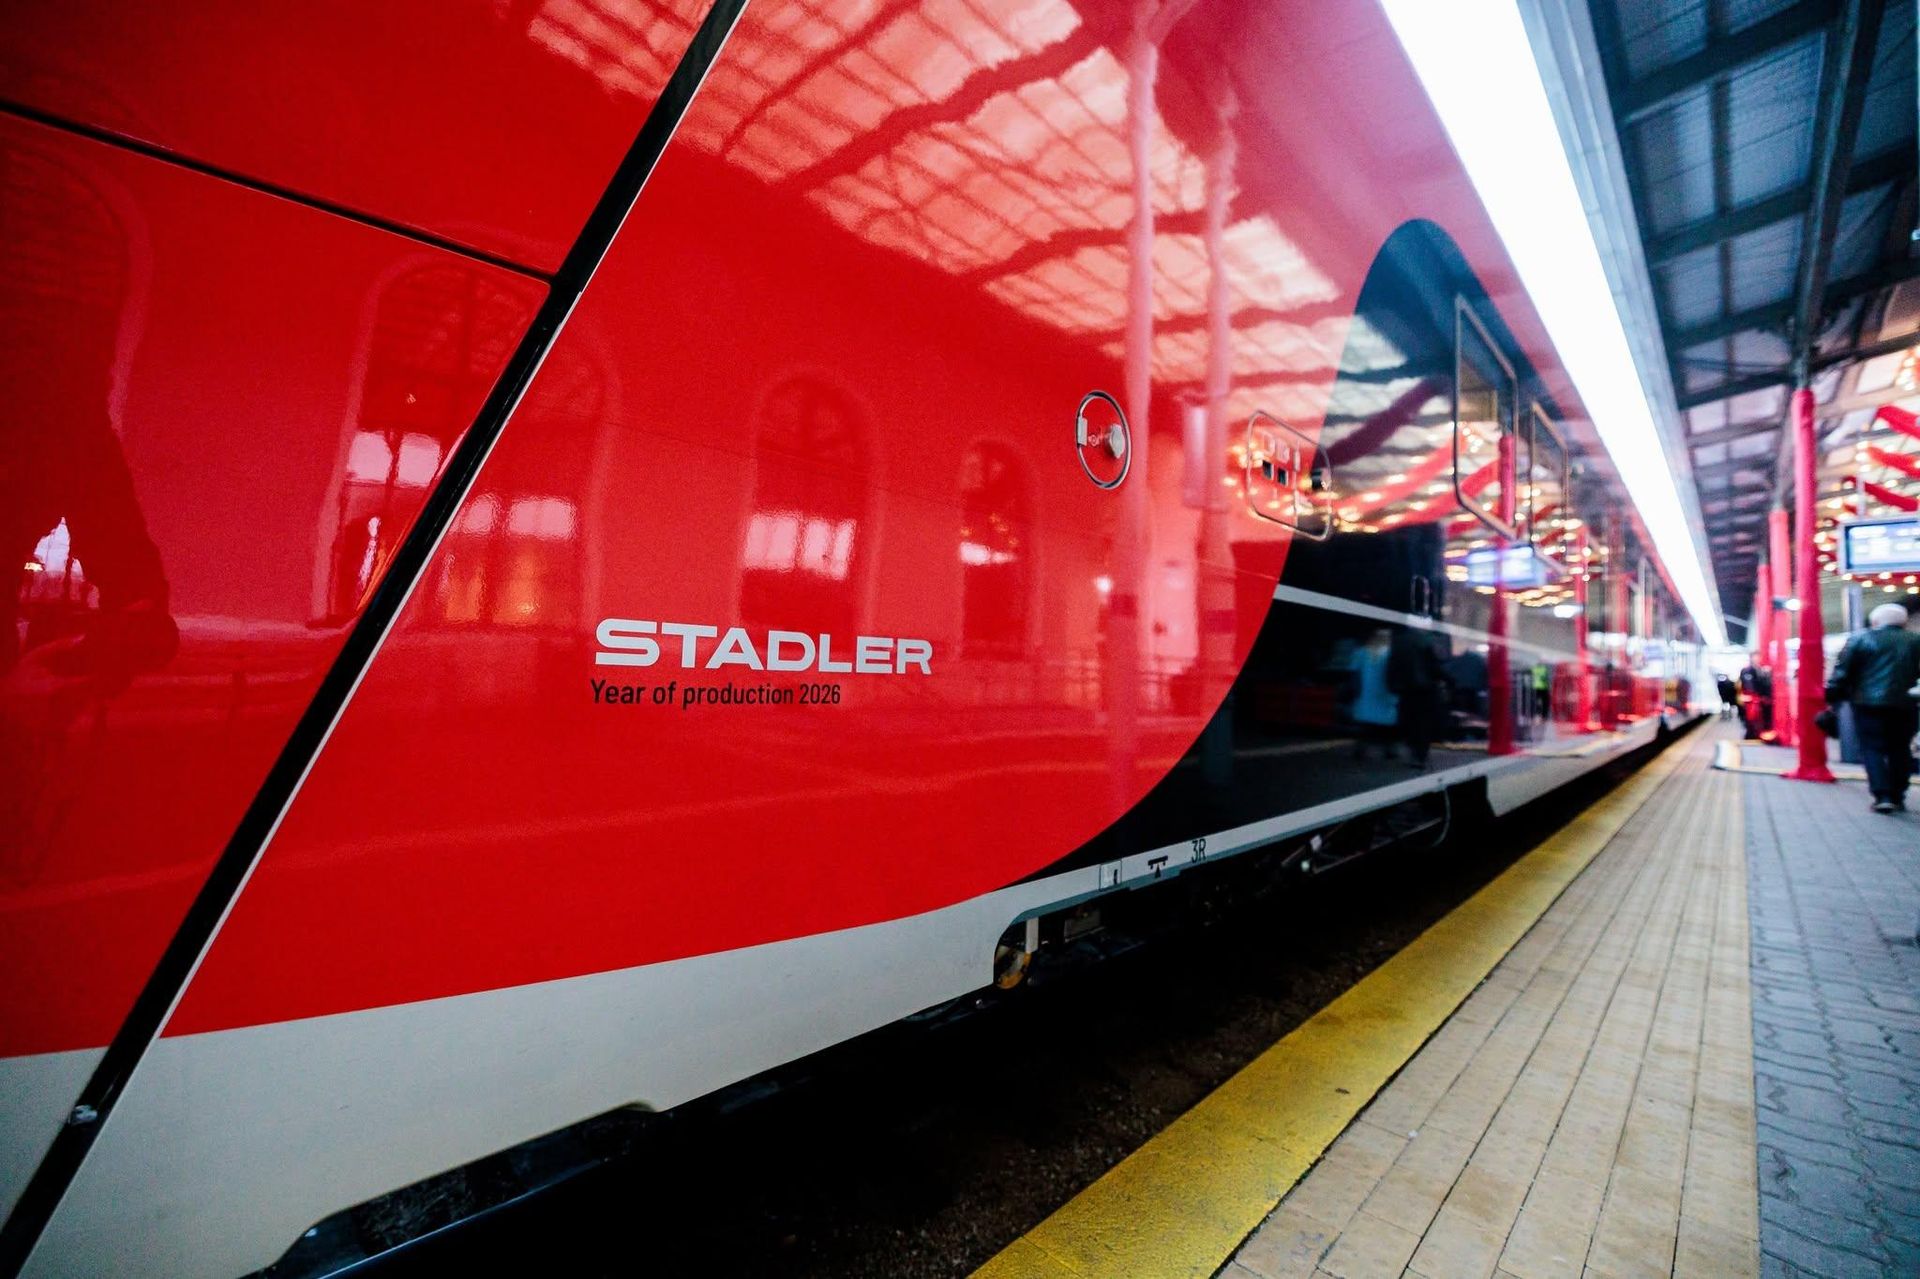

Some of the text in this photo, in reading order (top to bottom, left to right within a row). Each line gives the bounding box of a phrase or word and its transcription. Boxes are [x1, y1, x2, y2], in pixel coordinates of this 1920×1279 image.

[595, 618, 932, 675] STADLER
[591, 679, 841, 710] Year of production 2026
[1191, 838, 1207, 863] 3R
